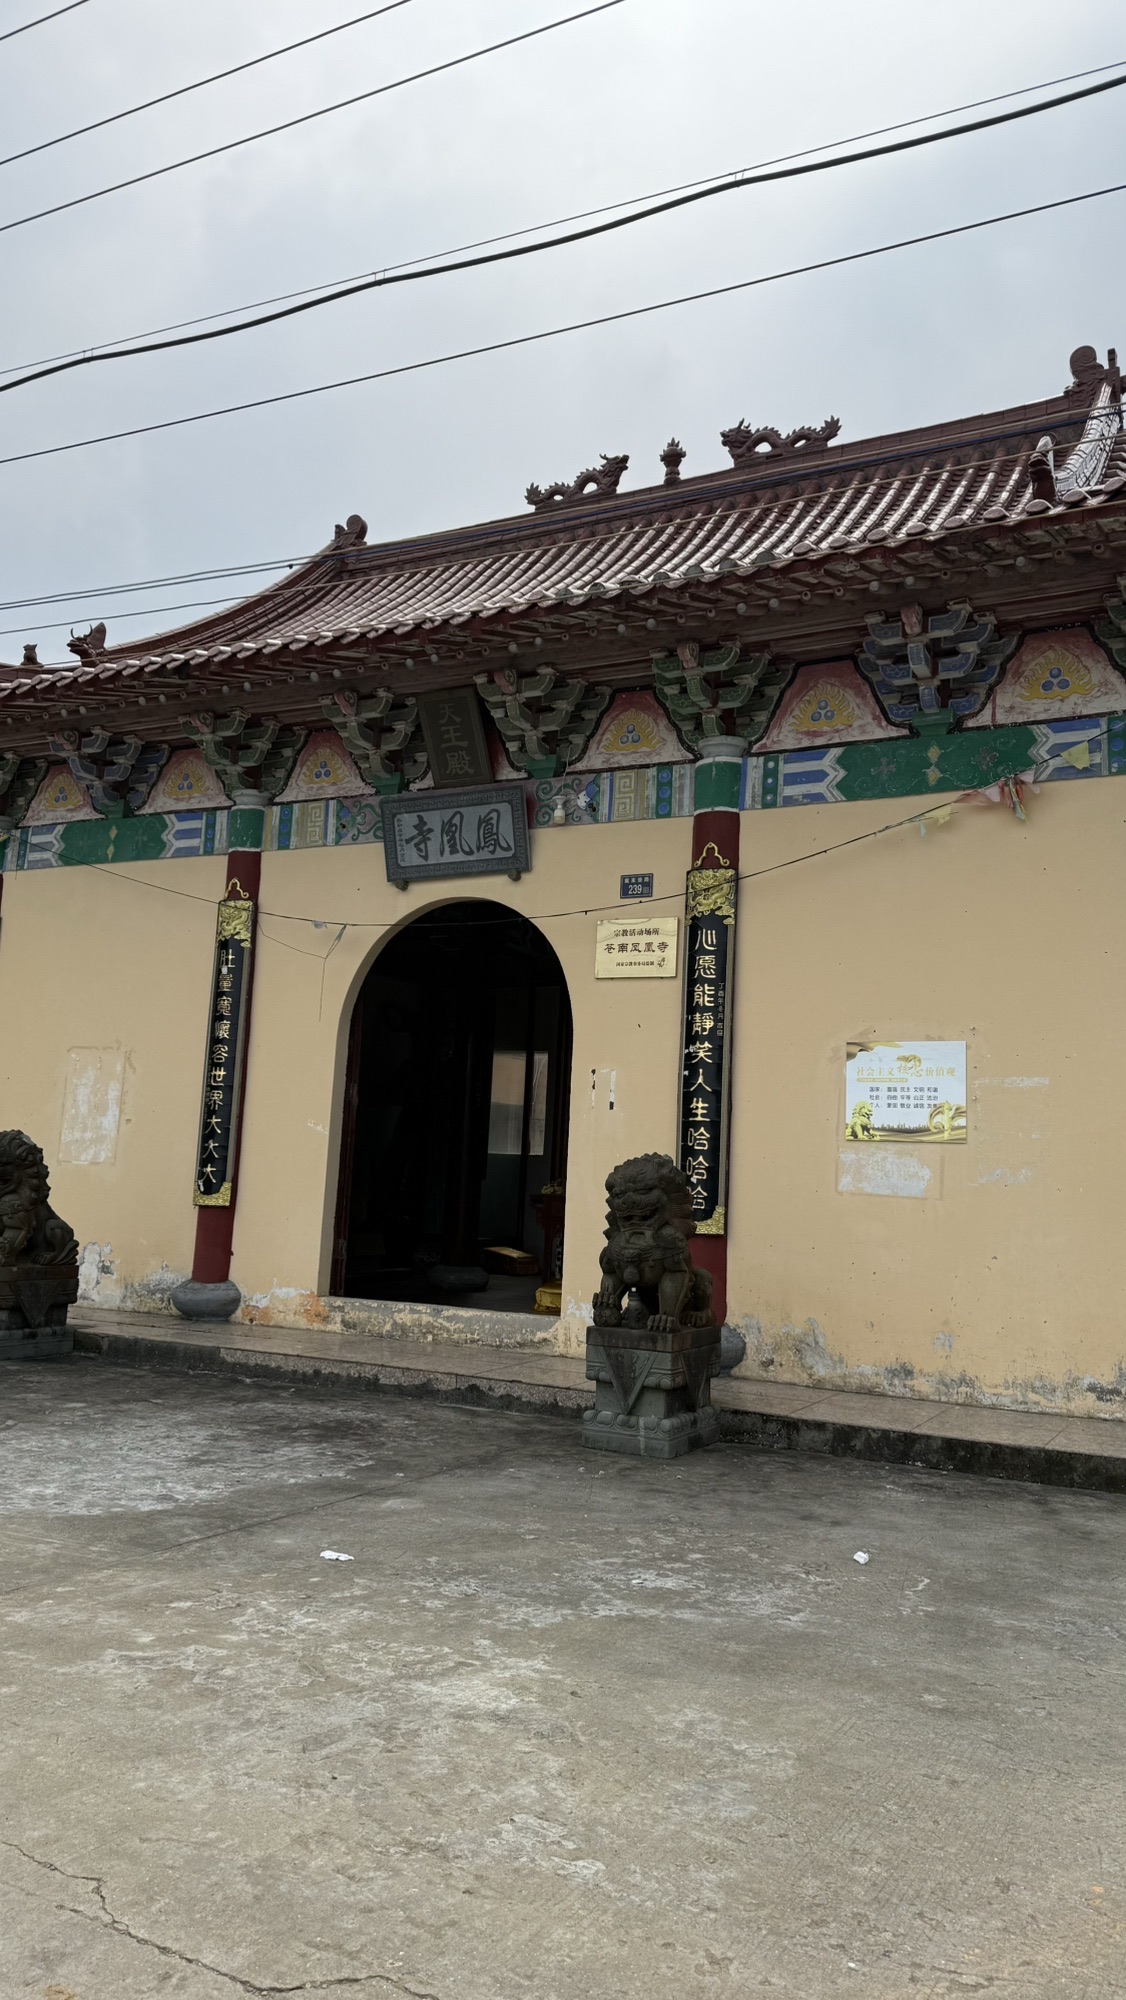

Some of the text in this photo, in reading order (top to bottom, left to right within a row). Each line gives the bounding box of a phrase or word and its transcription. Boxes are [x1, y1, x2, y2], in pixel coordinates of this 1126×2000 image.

[438, 704, 475, 775] 天王殿
[628, 884, 643, 895] 239
[613, 928, 660, 938] 宗教活动场所
[604, 941, 669, 954] 苍南凤凰寺
[857, 1060, 956, 1077] 社会主义核心价值观
